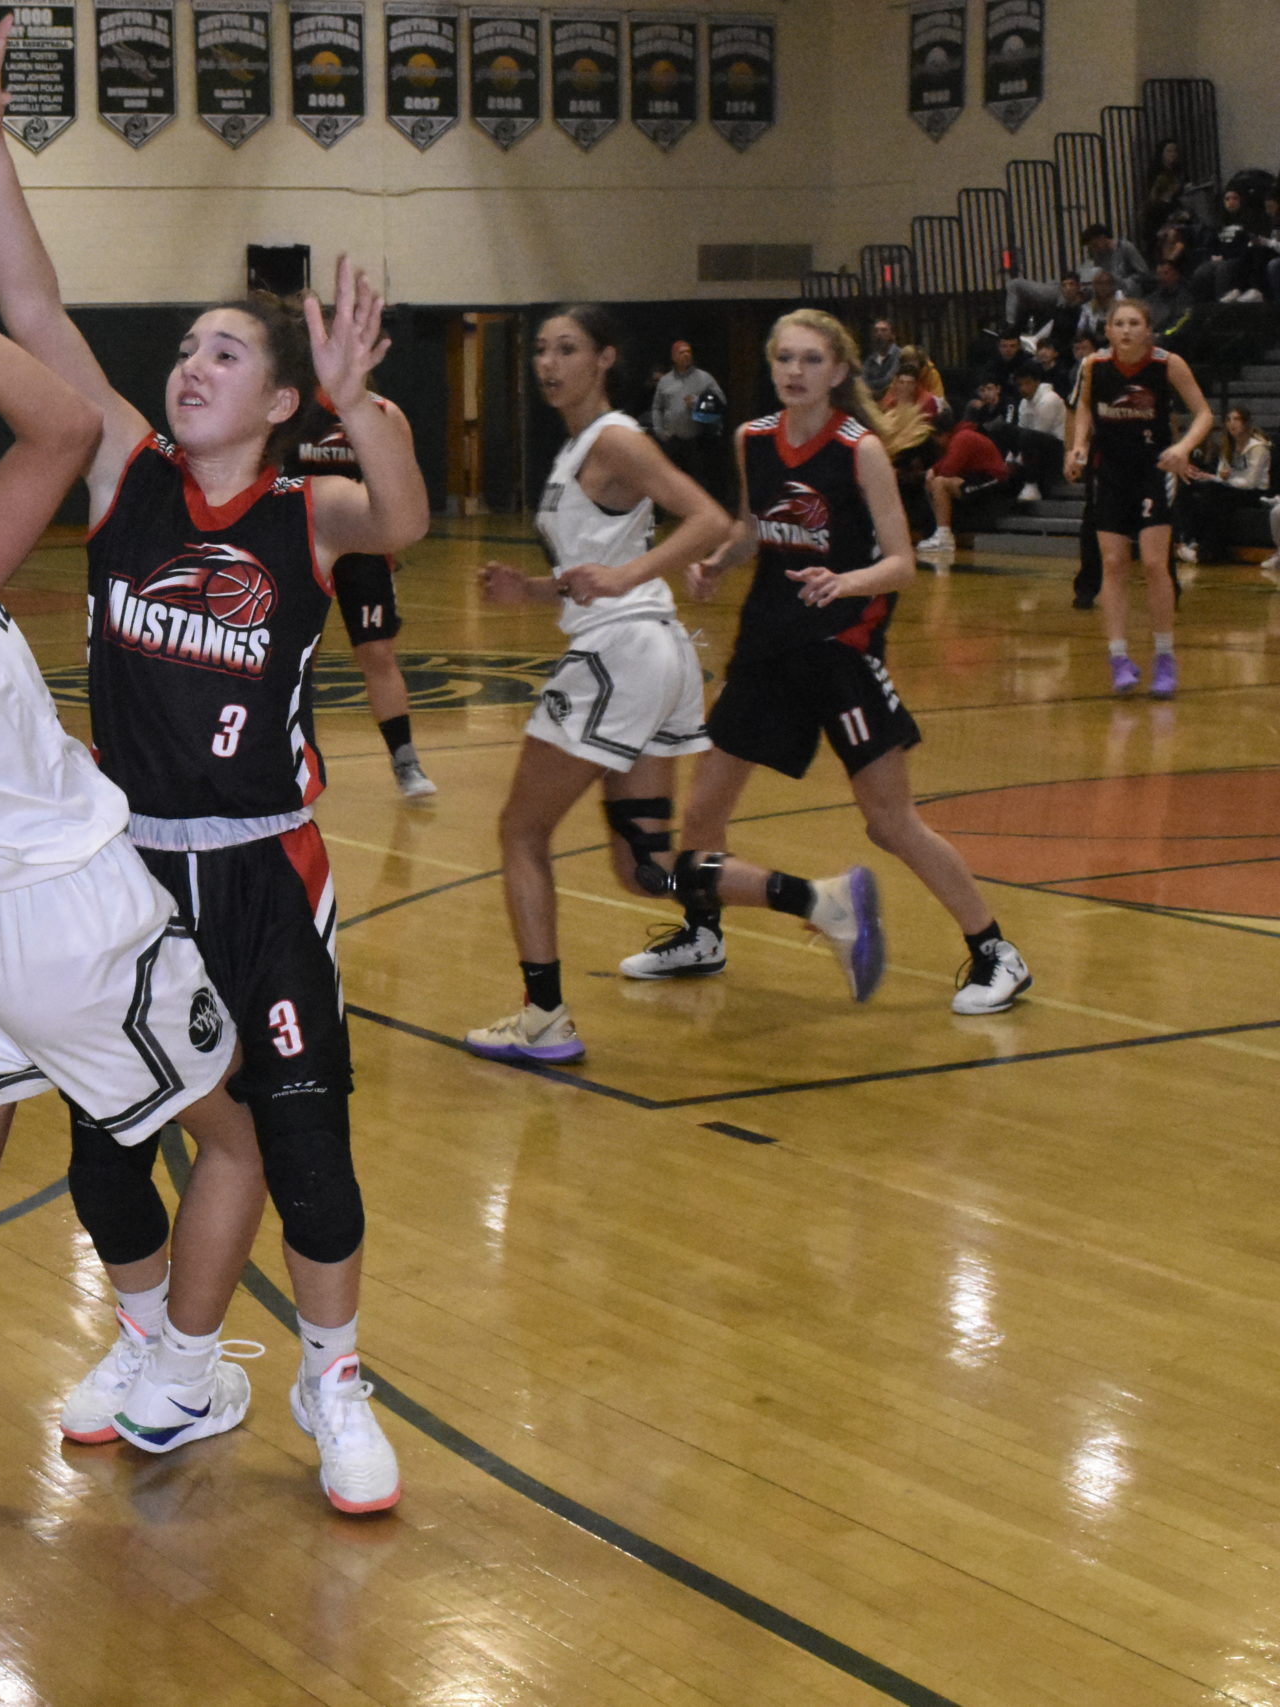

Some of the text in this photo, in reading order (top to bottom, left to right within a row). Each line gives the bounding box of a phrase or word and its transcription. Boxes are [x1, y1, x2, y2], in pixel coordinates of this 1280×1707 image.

[13, 8, 53, 26] 1000
[293, 31, 360, 51] CHAMPIONS
[27, 73, 61, 81] JOHNSON
[1141, 498, 1153, 518] 2
[107, 577, 271, 675] MUSTANGS
[361, 604, 384, 628] 14
[211, 704, 248, 758] 3
[839, 706, 871, 747] 11
[268, 1000, 304, 1058] 3
